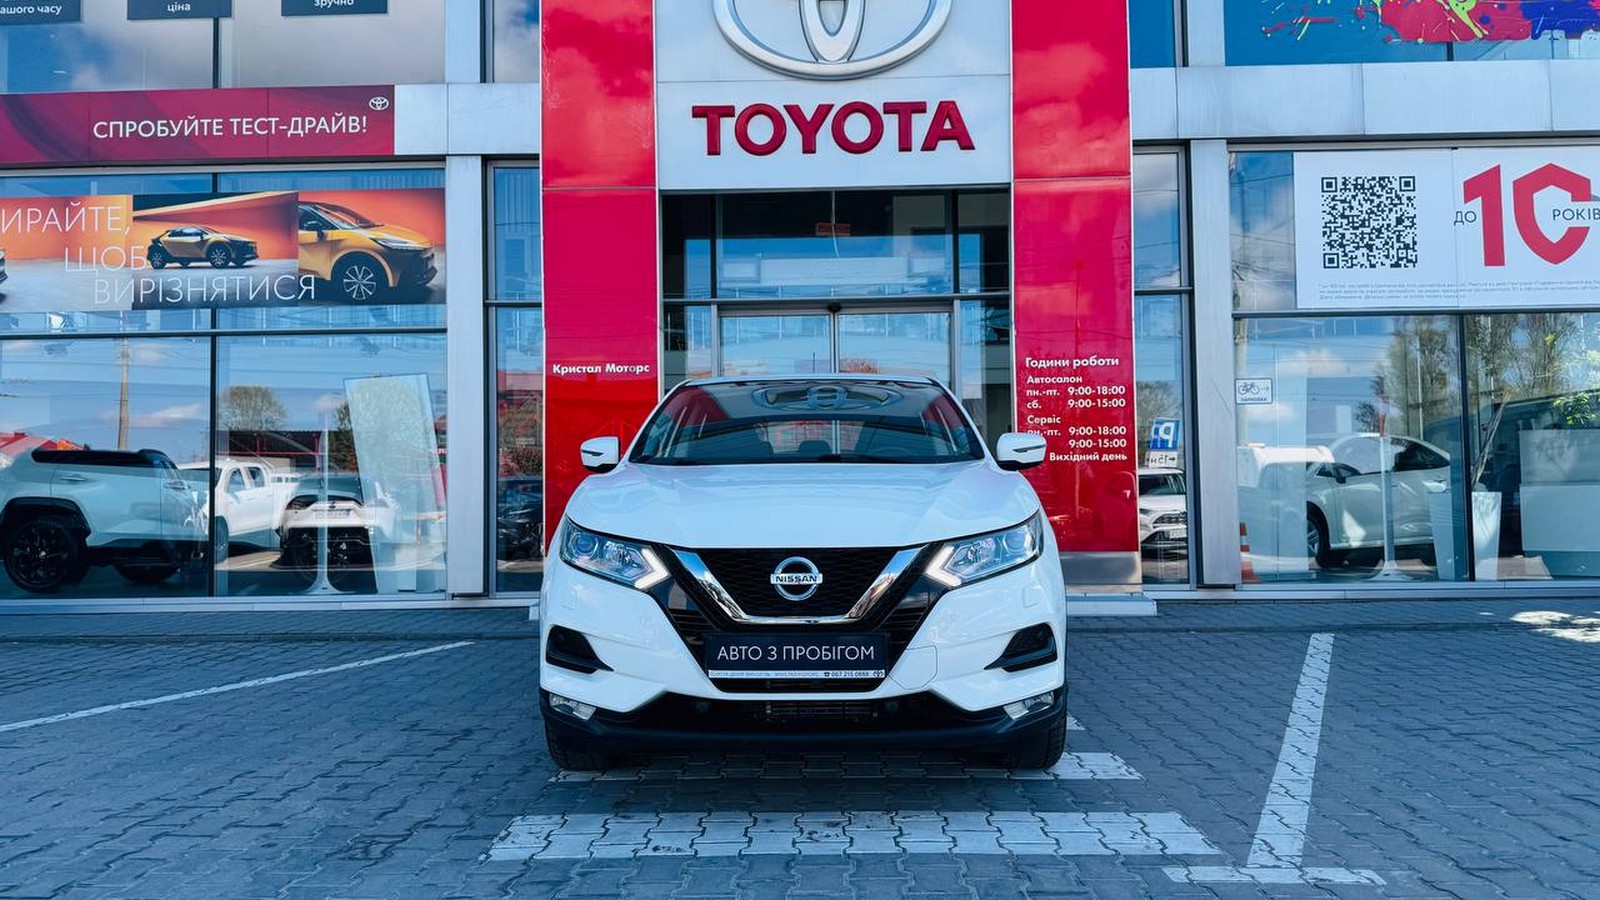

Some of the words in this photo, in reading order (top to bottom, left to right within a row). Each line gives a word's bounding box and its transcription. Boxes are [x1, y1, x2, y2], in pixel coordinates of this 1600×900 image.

[167, 2, 191, 13] ціна
[314, 0, 355, 8] зручно
[37, 5, 62, 15] часу
[93, 115, 224, 139] СПРОБУЙТЕ
[229, 112, 368, 137] ТЕСТ-ДРАЙВ!
[691, 100, 976, 157] TOYOTA
[1, 201, 131, 236] ИРАЙТЕ,
[1453, 210, 1478, 228] ДО
[1552, 207, 1600, 222] РОКІВ
[64, 246, 148, 278] ЩОБ
[93, 274, 316, 305] ВИРІЗНЯТИСЯ
[1025, 357, 1070, 369] Години
[1072, 355, 1120, 370] роботи
[552, 364, 602, 376] Кристал
[605, 363, 650, 375] Моторс
[1026, 375, 1083, 384] Автосалон
[1026, 389, 1060, 397] пн.-пт.
[1067, 385, 1126, 396] 9:00-18:00
[1026, 400, 1042, 409] сб.
[1067, 398, 1126, 409] 9:00-15:00
[1027, 415, 1061, 426] Сервіс
[1068, 426, 1127, 436] 9:00-18:00
[1068, 438, 1127, 449] 9:00-15:00
[1049, 452, 1100, 463] Вихідний
[1101, 452, 1128, 462] день
[775, 575, 818, 583] NISSAN
[716, 645, 763, 661] АВТО
[767, 645, 778, 661] З
[782, 645, 875, 661] ПРОБІГОМ
